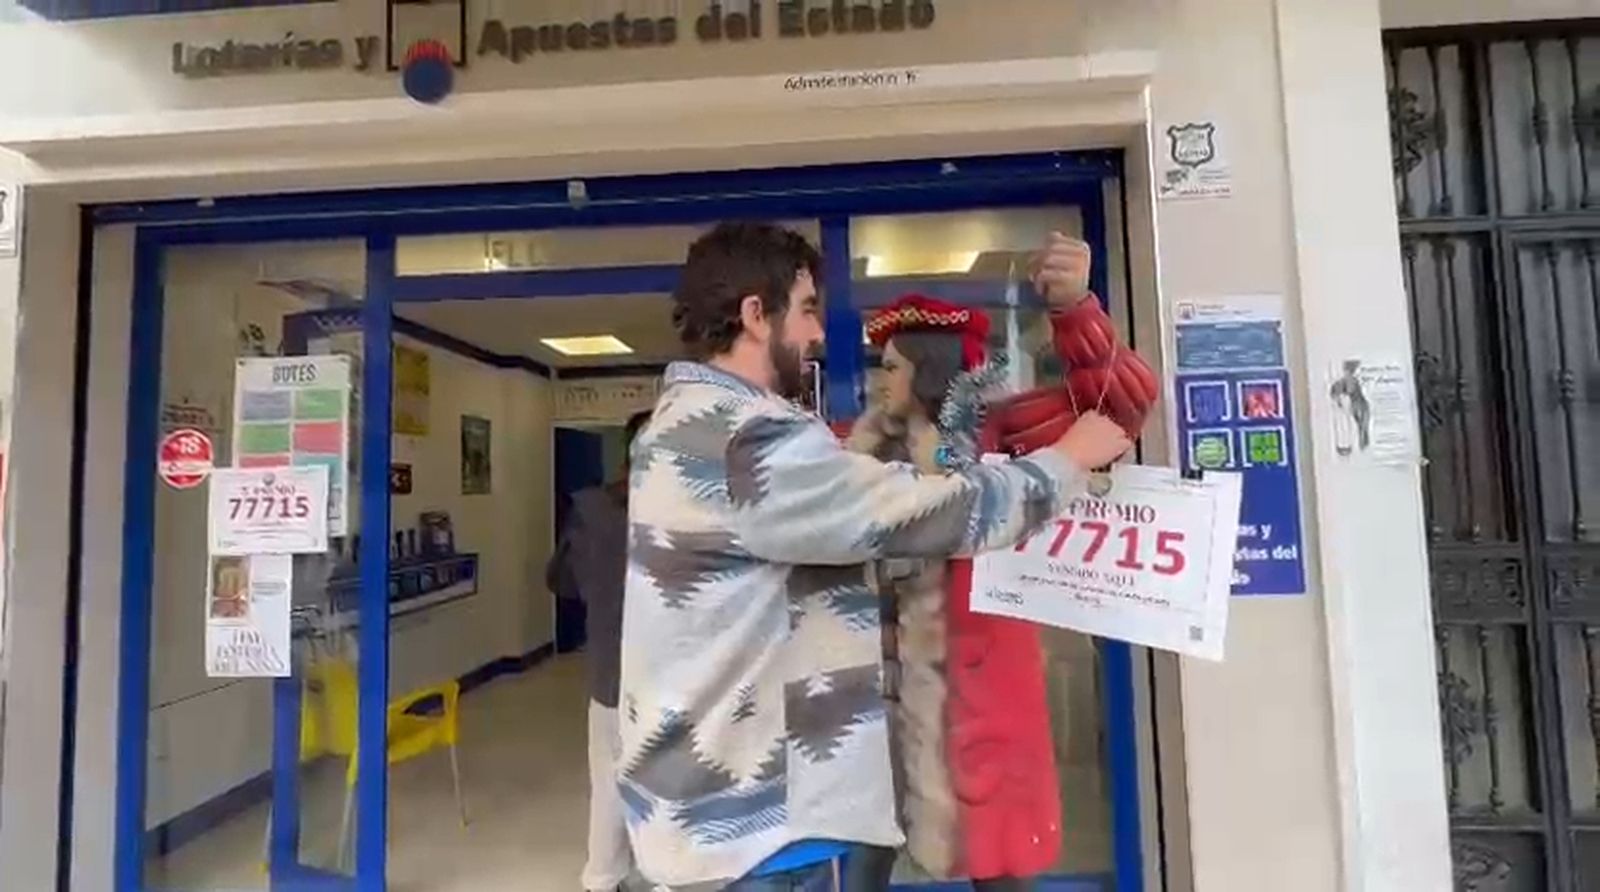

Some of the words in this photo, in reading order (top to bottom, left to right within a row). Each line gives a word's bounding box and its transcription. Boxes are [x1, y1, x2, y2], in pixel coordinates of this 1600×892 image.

[354, 35, 381, 73] y
[478, 12, 677, 62] Apuestas
[695, 0, 762, 41] del
[777, 0, 935, 38] Estado
[272, 364, 318, 384] BOTES
[229, 496, 309, 520] 77715
[1069, 497, 1156, 524] PREMIO
[1261, 524, 1272, 540] y
[1272, 544, 1298, 560] del
